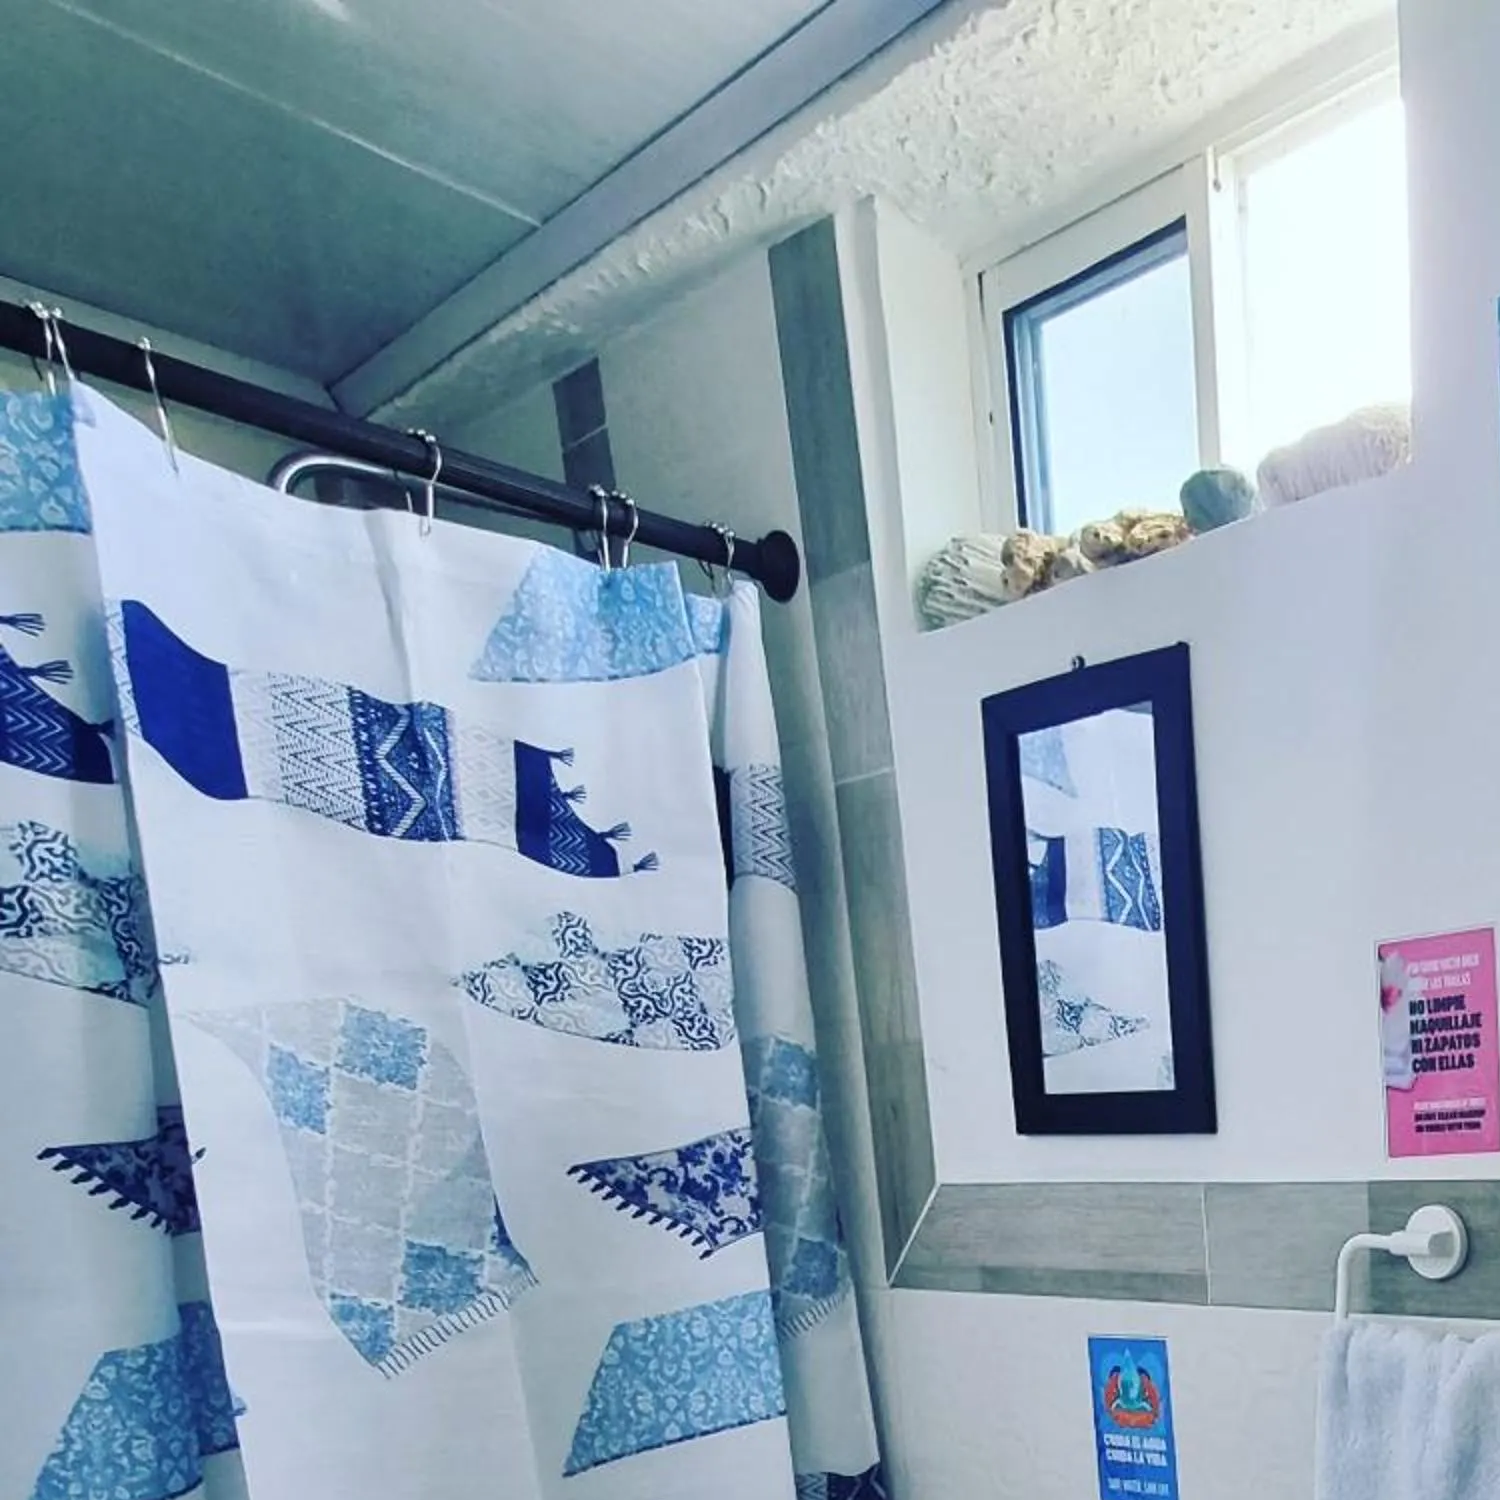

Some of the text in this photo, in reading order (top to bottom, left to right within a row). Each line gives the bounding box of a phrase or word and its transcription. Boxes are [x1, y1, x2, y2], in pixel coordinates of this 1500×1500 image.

[1409, 994, 1466, 1016] NO LIMPIE
[1410, 1012, 1482, 1034] MAQUILLAJE
[1411, 1033, 1481, 1054] NI ZAPATOS
[1412, 1053, 1475, 1073] CON ELLAS
